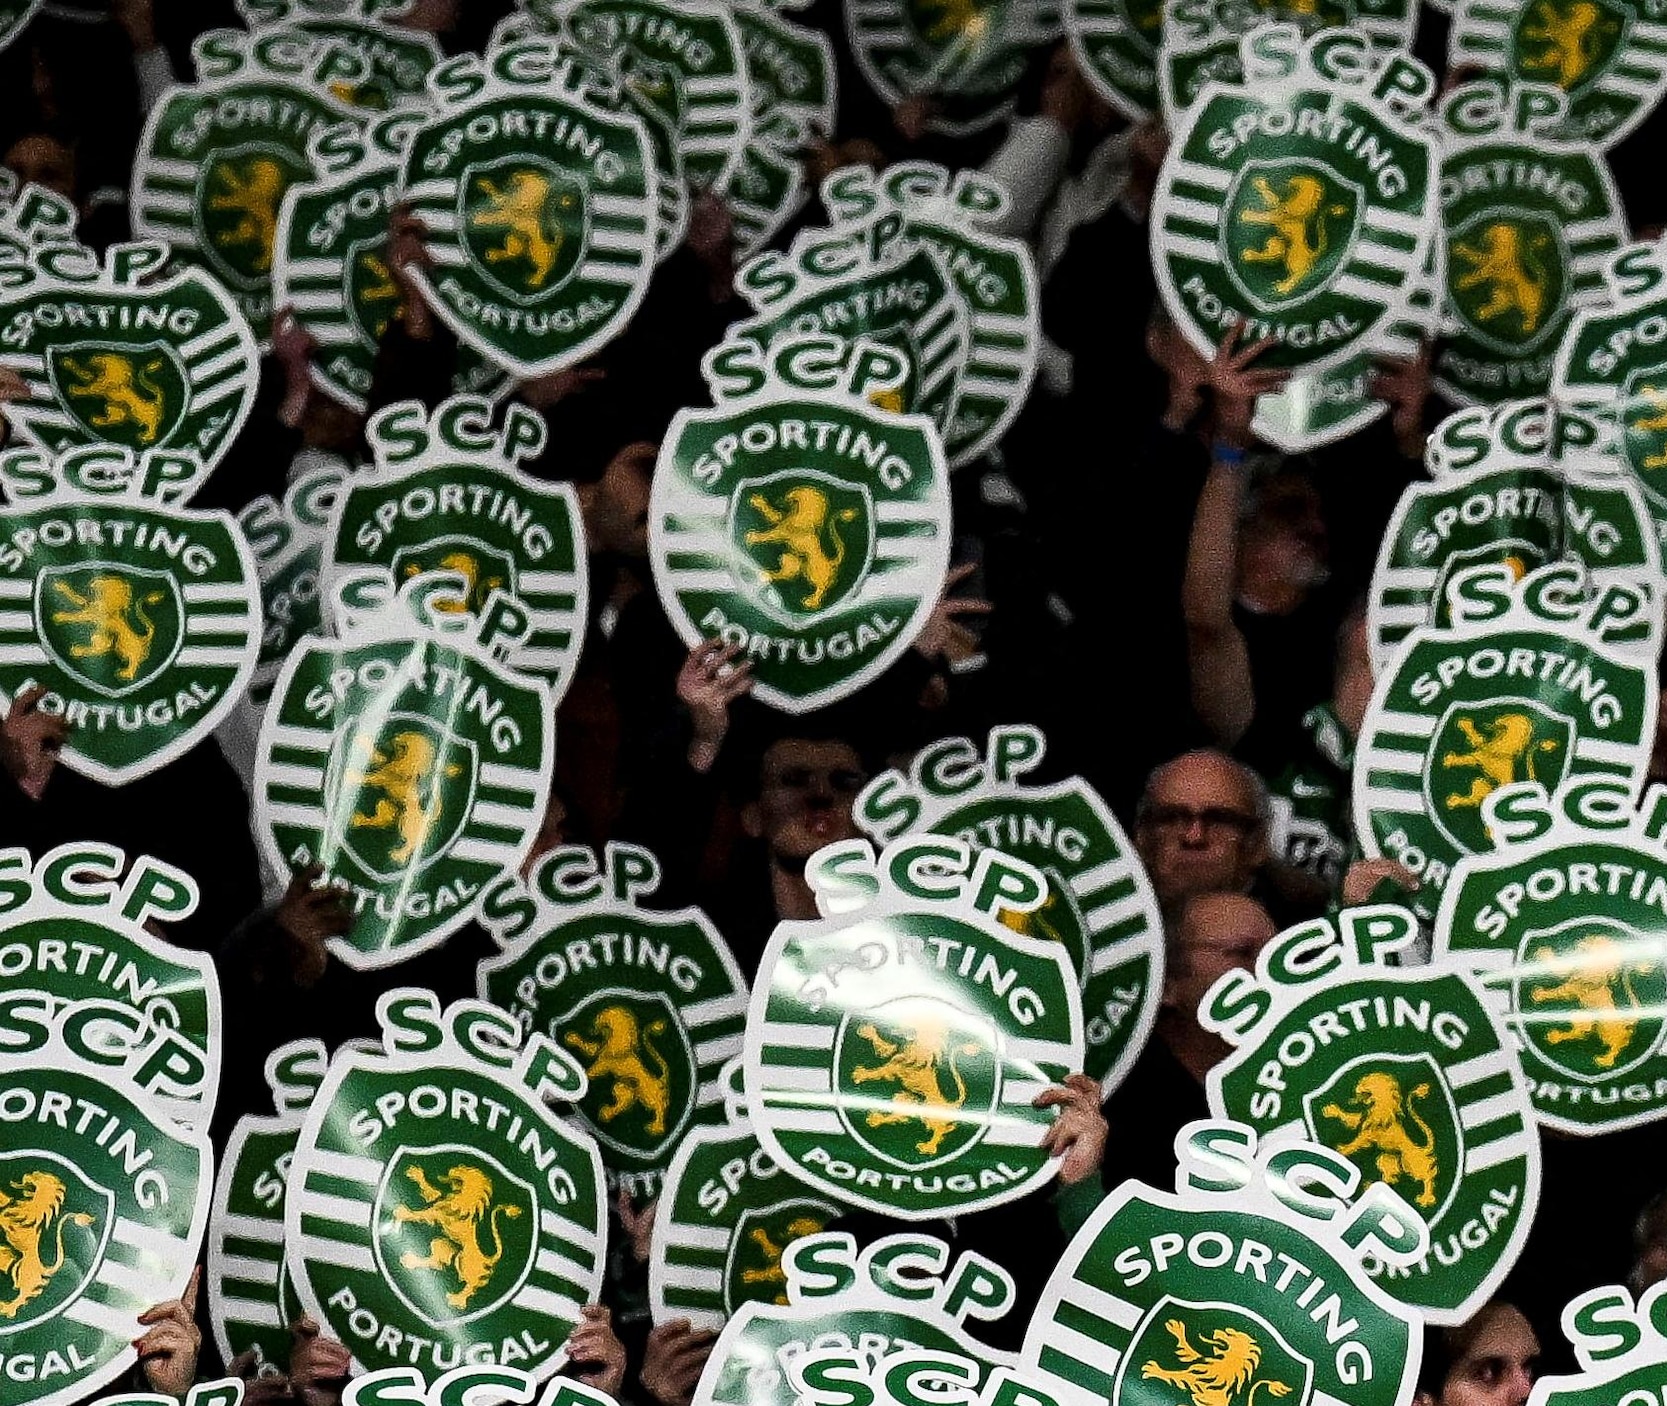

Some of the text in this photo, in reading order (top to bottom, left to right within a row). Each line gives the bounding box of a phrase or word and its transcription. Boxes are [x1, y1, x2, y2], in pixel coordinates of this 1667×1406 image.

[1248, 29, 1432, 106] SCP
[425, 111, 628, 187] SPORTING
[1206, 103, 1408, 204] SPORTING
[744, 212, 900, 304] SCP
[439, 276, 619, 334] PORTUGAL
[707, 339, 909, 402] SCP
[374, 401, 558, 466] SCP
[690, 413, 914, 495] SPORTING
[0, 449, 200, 505] SCP
[0, 511, 219, 578] SPORTING
[353, 480, 556, 563] SPORTING
[340, 576, 539, 652] SCP
[701, 607, 900, 665] PORTUGAL
[1455, 570, 1651, 635] SCP
[1408, 643, 1622, 731] SPORTING
[871, 737, 1040, 832] SCP
[477, 845, 662, 943] SCP
[810, 845, 1044, 917] SCP
[506, 932, 705, 1037] SPORTING
[1212, 912, 1412, 1030] SCP
[383, 991, 584, 1098] SCP
[1249, 996, 1470, 1124] SPORTING
[345, 1081, 578, 1206] SPORTING
[804, 1151, 1028, 1218] PORTUGAL
[1183, 1120, 1425, 1262] SCP
[793, 1241, 1012, 1316] SCP
[1110, 1226, 1374, 1392] SPORTING
[331, 1289, 549, 1376] PORTUGAL
